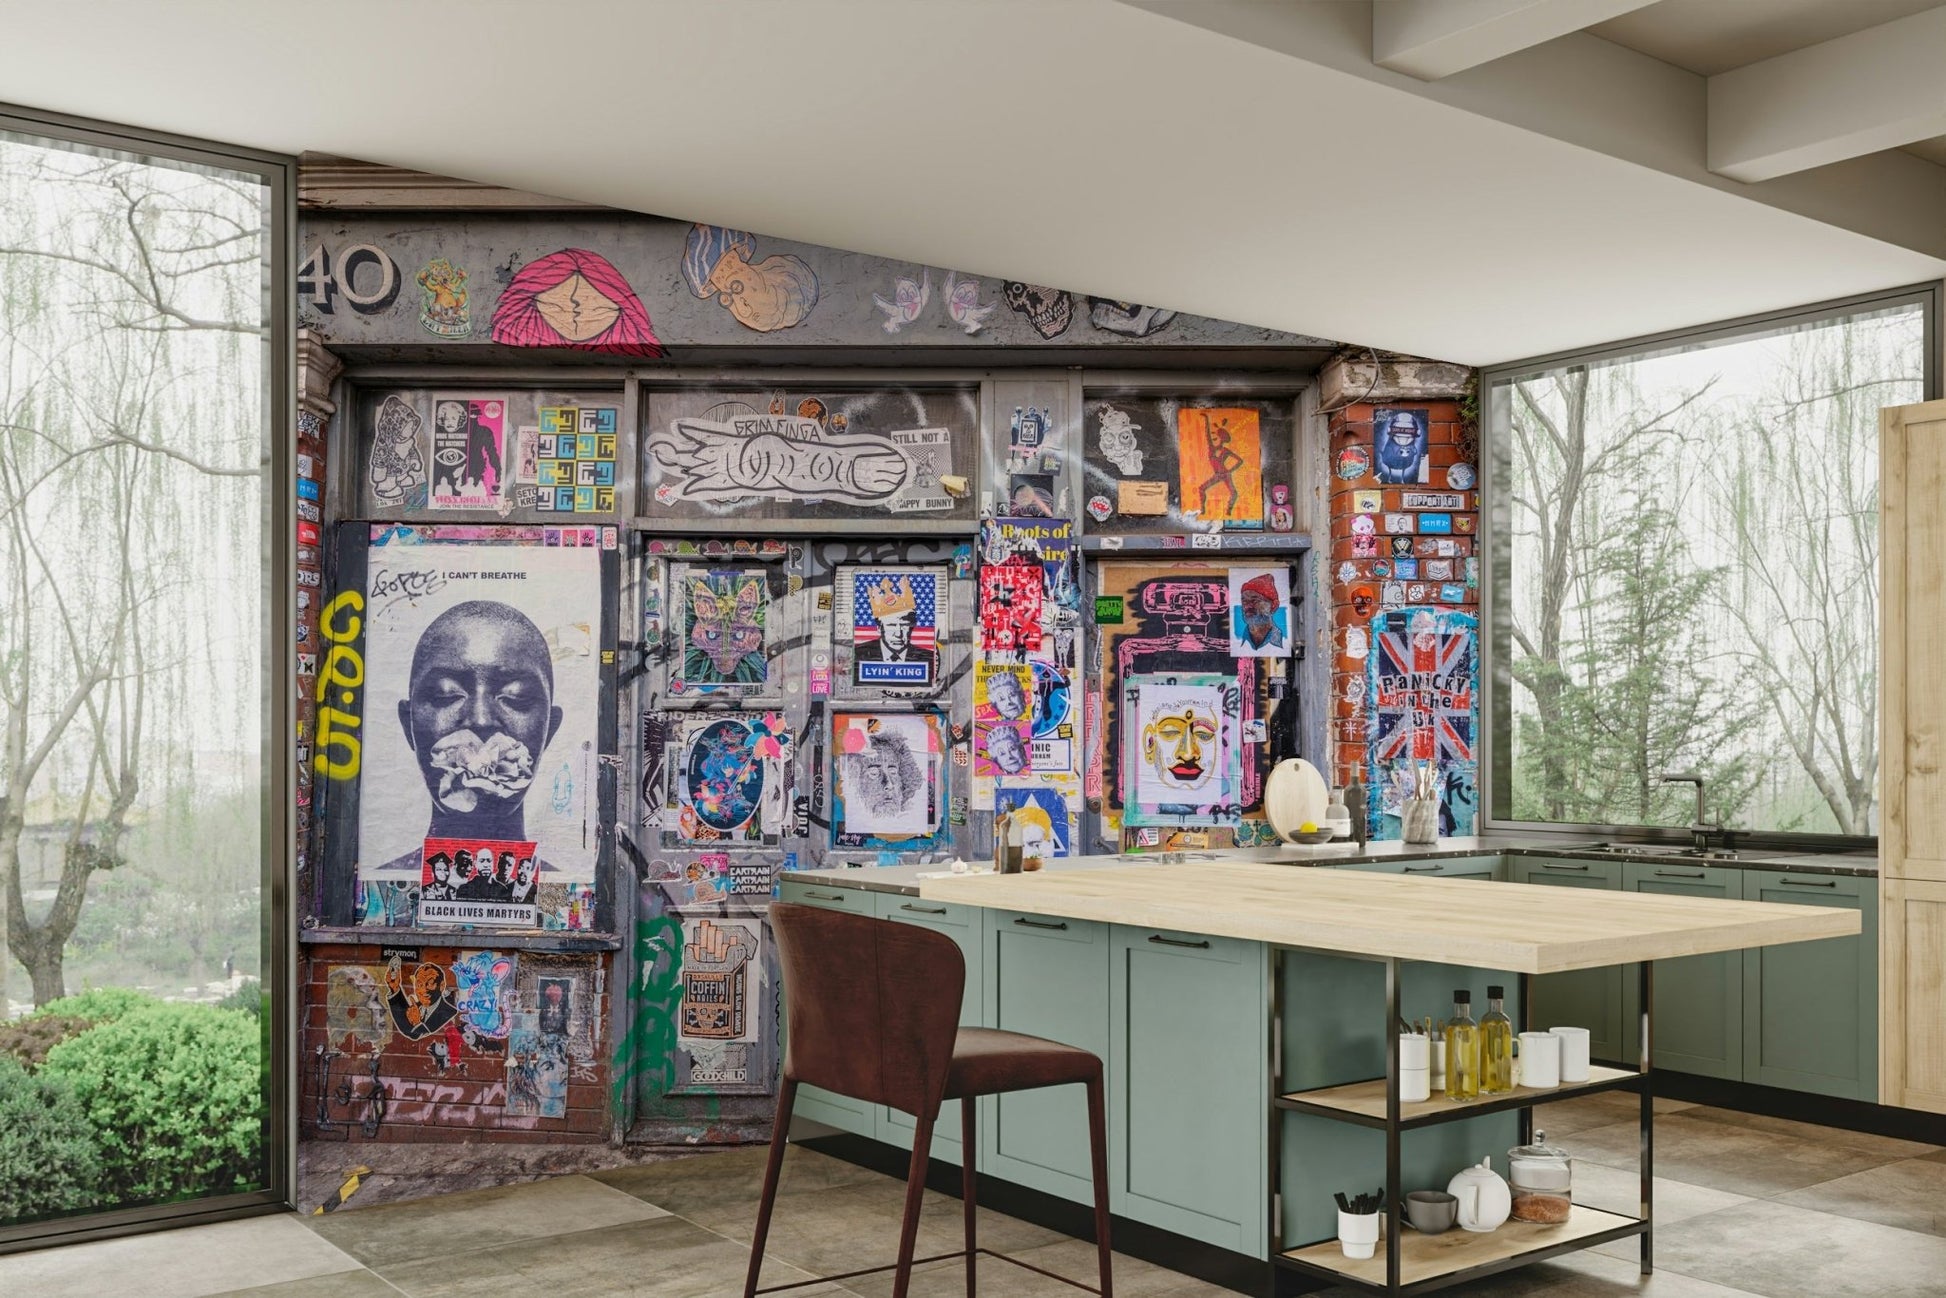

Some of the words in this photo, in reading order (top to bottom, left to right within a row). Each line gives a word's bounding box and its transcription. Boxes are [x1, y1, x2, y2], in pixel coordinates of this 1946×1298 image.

[298, 243, 400, 315] 40
[892, 434, 918, 445] STILL
[921, 433, 939, 443] NOT
[899, 499, 920, 509] APPY
[926, 499, 952, 508] BUNNY
[1052, 523, 1072, 539] of
[442, 572, 446, 580] I
[449, 572, 478, 580] CAN'T
[481, 572, 527, 580] BREATHE
[865, 667, 893, 676] LYIN'
[896, 668, 922, 676] KING
[981, 665, 1005, 674] NEVER
[1007, 665, 1025, 674] MIND
[425, 906, 455, 917] BLACK
[458, 907, 484, 918] LIVES
[486, 908, 531, 919] MARTYRS
[691, 981, 725, 996] COFFIN
